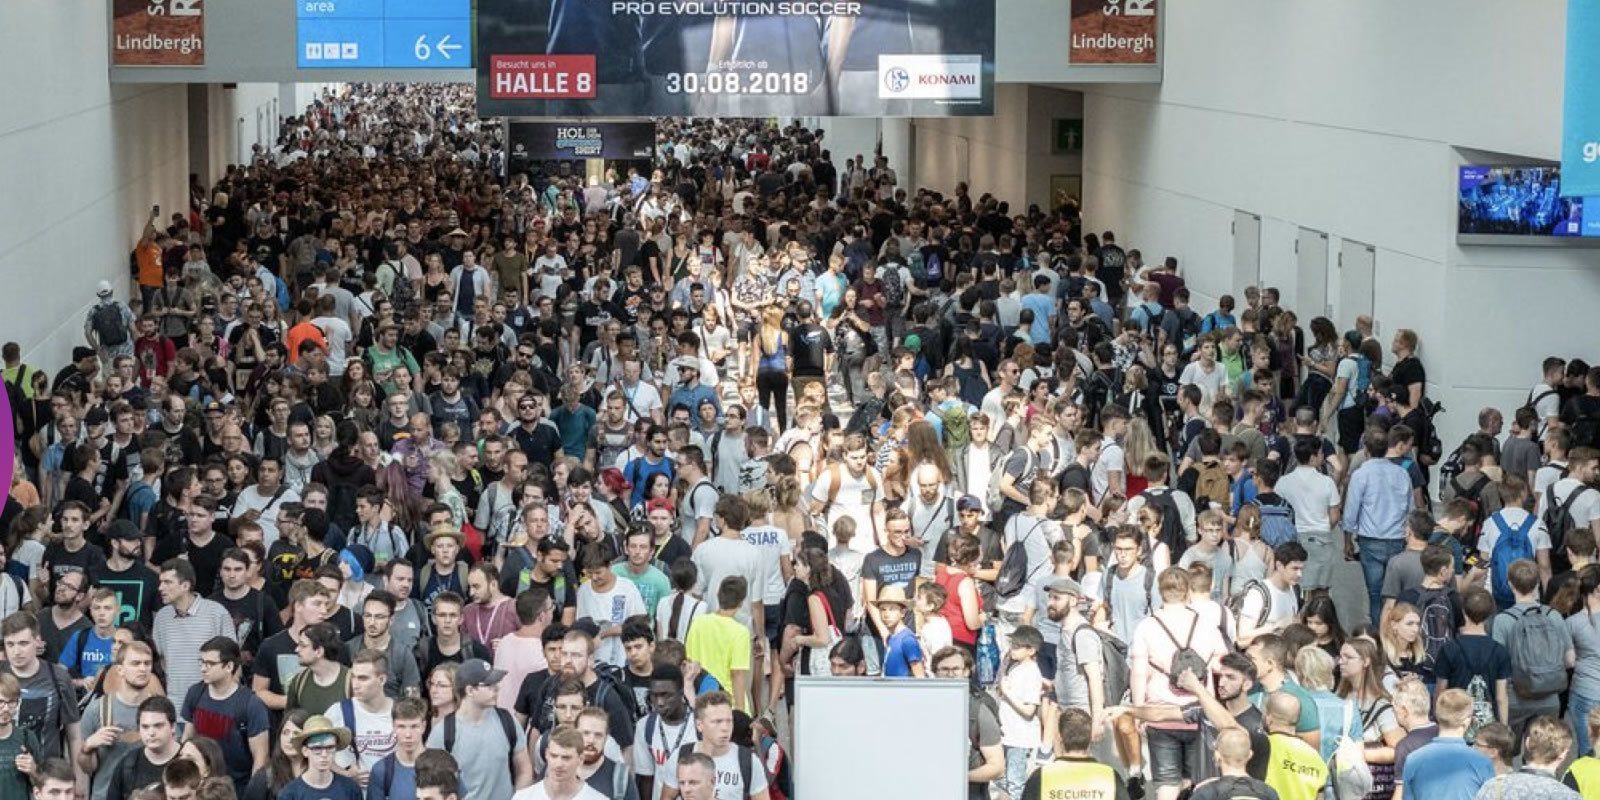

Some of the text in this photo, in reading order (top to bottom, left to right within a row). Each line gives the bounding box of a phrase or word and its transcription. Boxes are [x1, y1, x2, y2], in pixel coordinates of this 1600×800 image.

[305, 1, 335, 12] area
[611, 2, 861, 15] PRO EVOLUTION SOCCER
[117, 34, 202, 54] Lindbergh
[414, 34, 431, 60] 6
[1072, 32, 1154, 53] Lindbergh
[496, 60, 557, 69] Besucht uns in
[496, 72, 592, 93] HALLE 8
[666, 72, 808, 93] 30.08.2018
[918, 74, 977, 86] KONAMI
[557, 127, 586, 138] HOL
[1582, 142, 1600, 162] g
[717, 770, 739, 786] YOU
[1048, 789, 1105, 800] SECURITY
